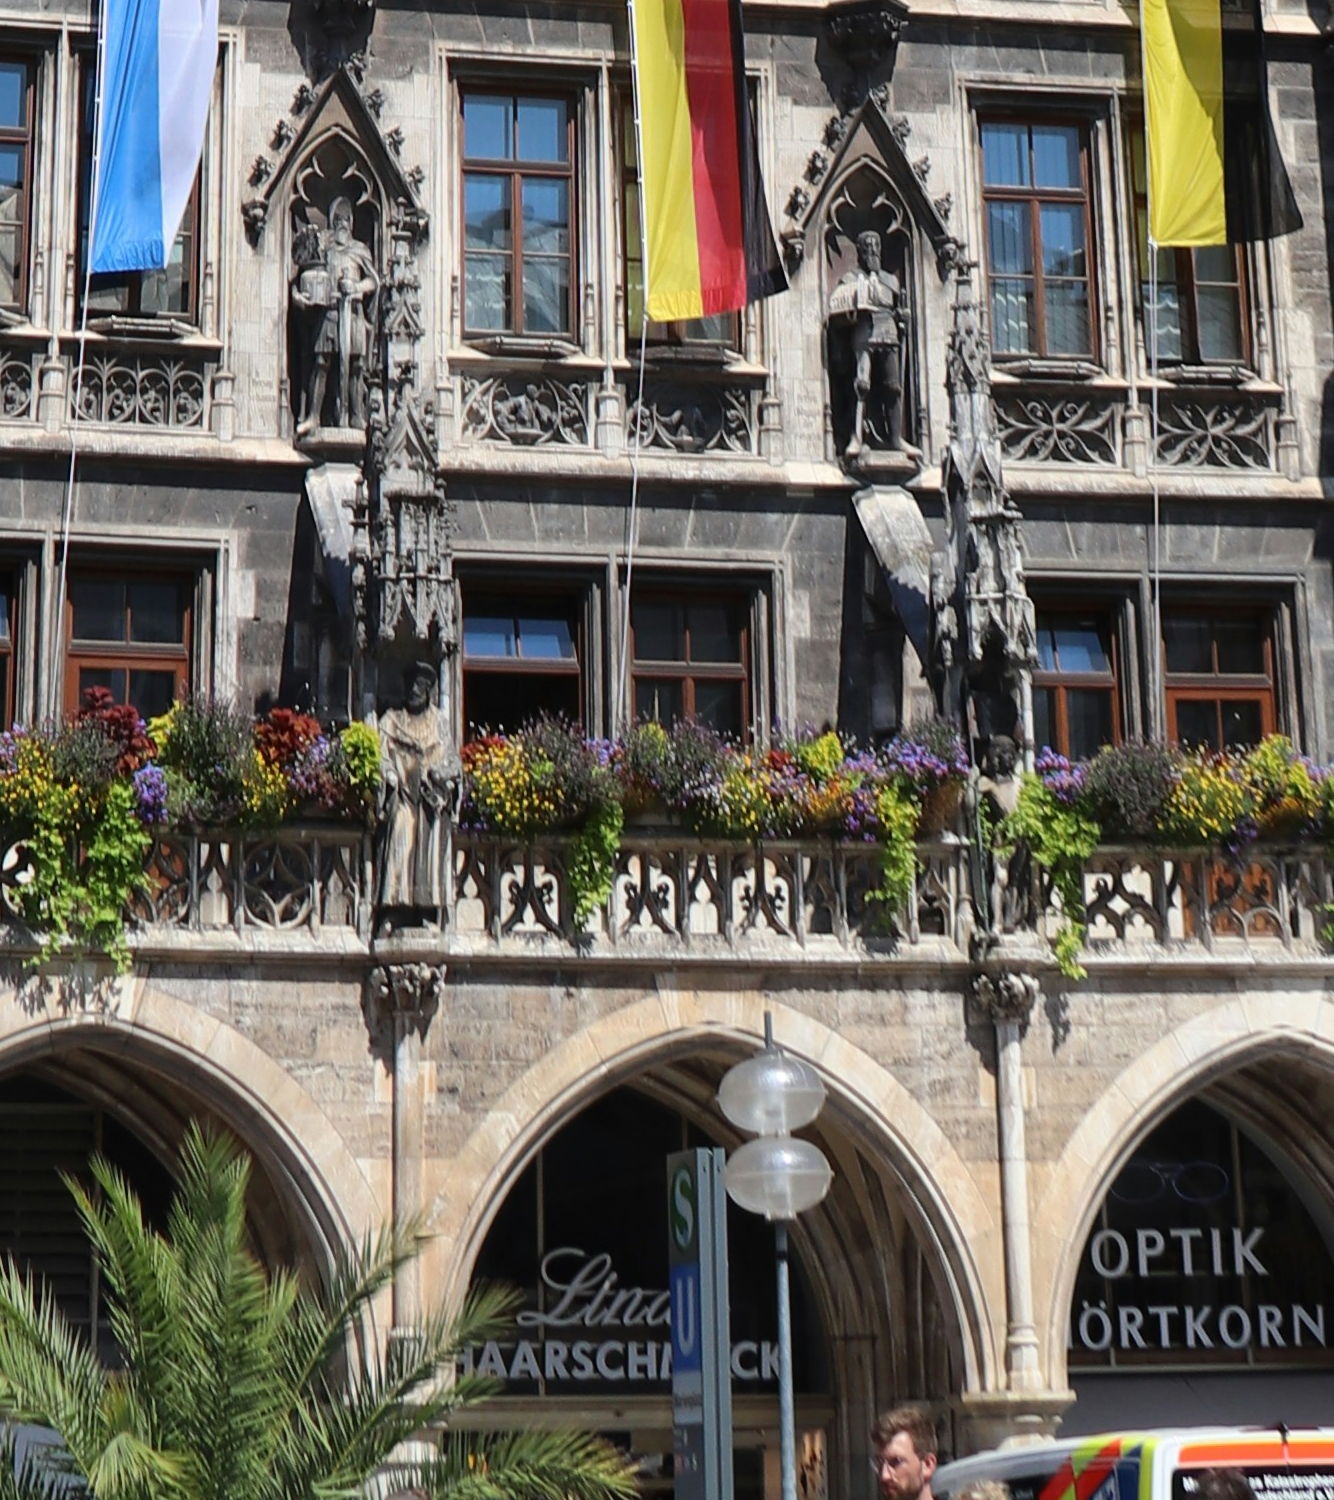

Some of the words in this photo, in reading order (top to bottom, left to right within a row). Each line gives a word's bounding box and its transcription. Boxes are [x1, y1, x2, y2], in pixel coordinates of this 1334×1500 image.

[674, 1167, 695, 1249] S
[1090, 1226, 1269, 1279] OPTIK
[517, 1247, 672, 1328] Lin
[675, 1275, 695, 1357] U
[1066, 1300, 1326, 1350] ÖRTKORN
[456, 1339, 781, 1381] HAARSCHCK
